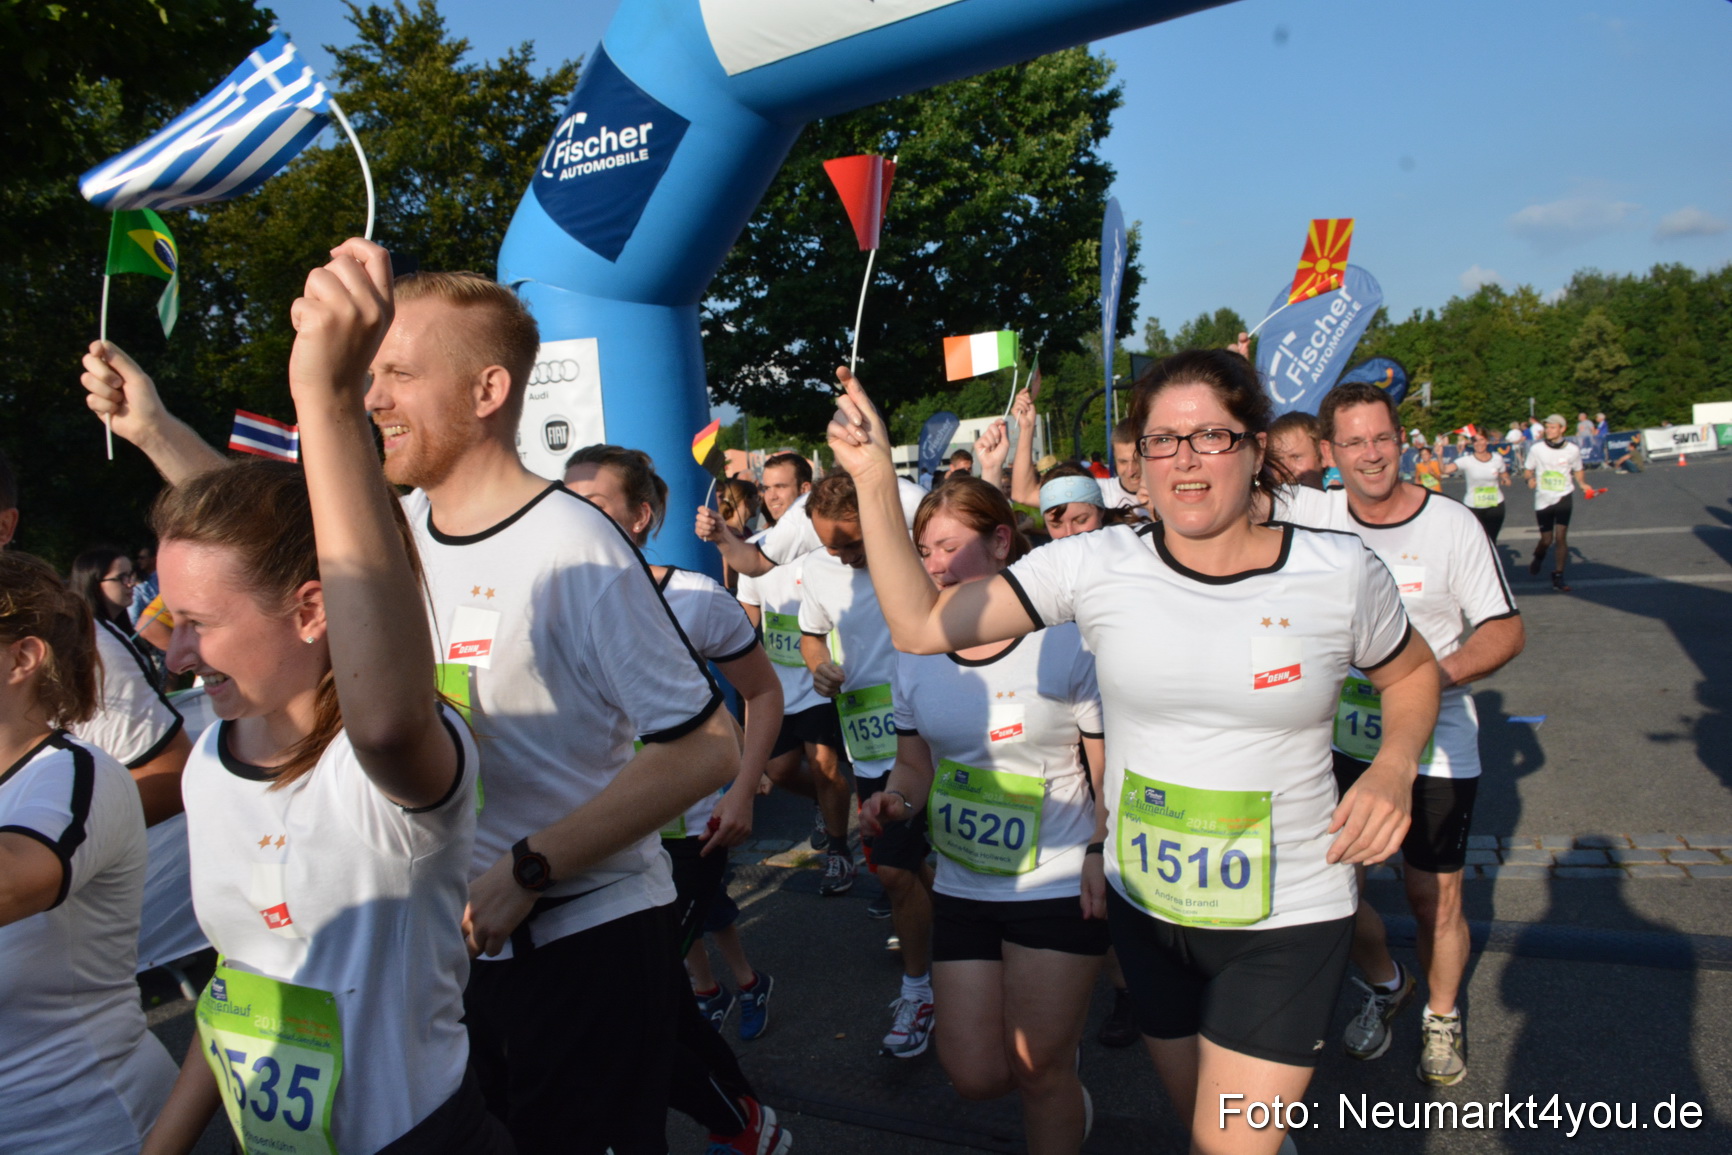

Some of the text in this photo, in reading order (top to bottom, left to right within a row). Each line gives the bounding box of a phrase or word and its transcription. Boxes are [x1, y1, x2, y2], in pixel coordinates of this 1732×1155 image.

[553, 122, 653, 169] Fischer
[559, 148, 649, 181] AUTOMOBILE
[1285, 285, 1353, 386] Fischer
[1310, 301, 1362, 383] AUTOMOBILE
[528, 391, 549, 400] Audi
[547, 425, 567, 445] FIAT
[459, 644, 480, 654] DEHN
[768, 632, 802, 651] 1514
[1267, 670, 1290, 684] DEHN
[849, 712, 897, 742] 1536
[1135, 798, 1186, 820] firmenlauf
[938, 803, 1025, 851] 1520
[1186, 817, 1217, 831] 2016
[1131, 832, 1251, 890] 1510
[1154, 888, 1219, 908] Andrea Brandl
[210, 1039, 321, 1132] 1535
